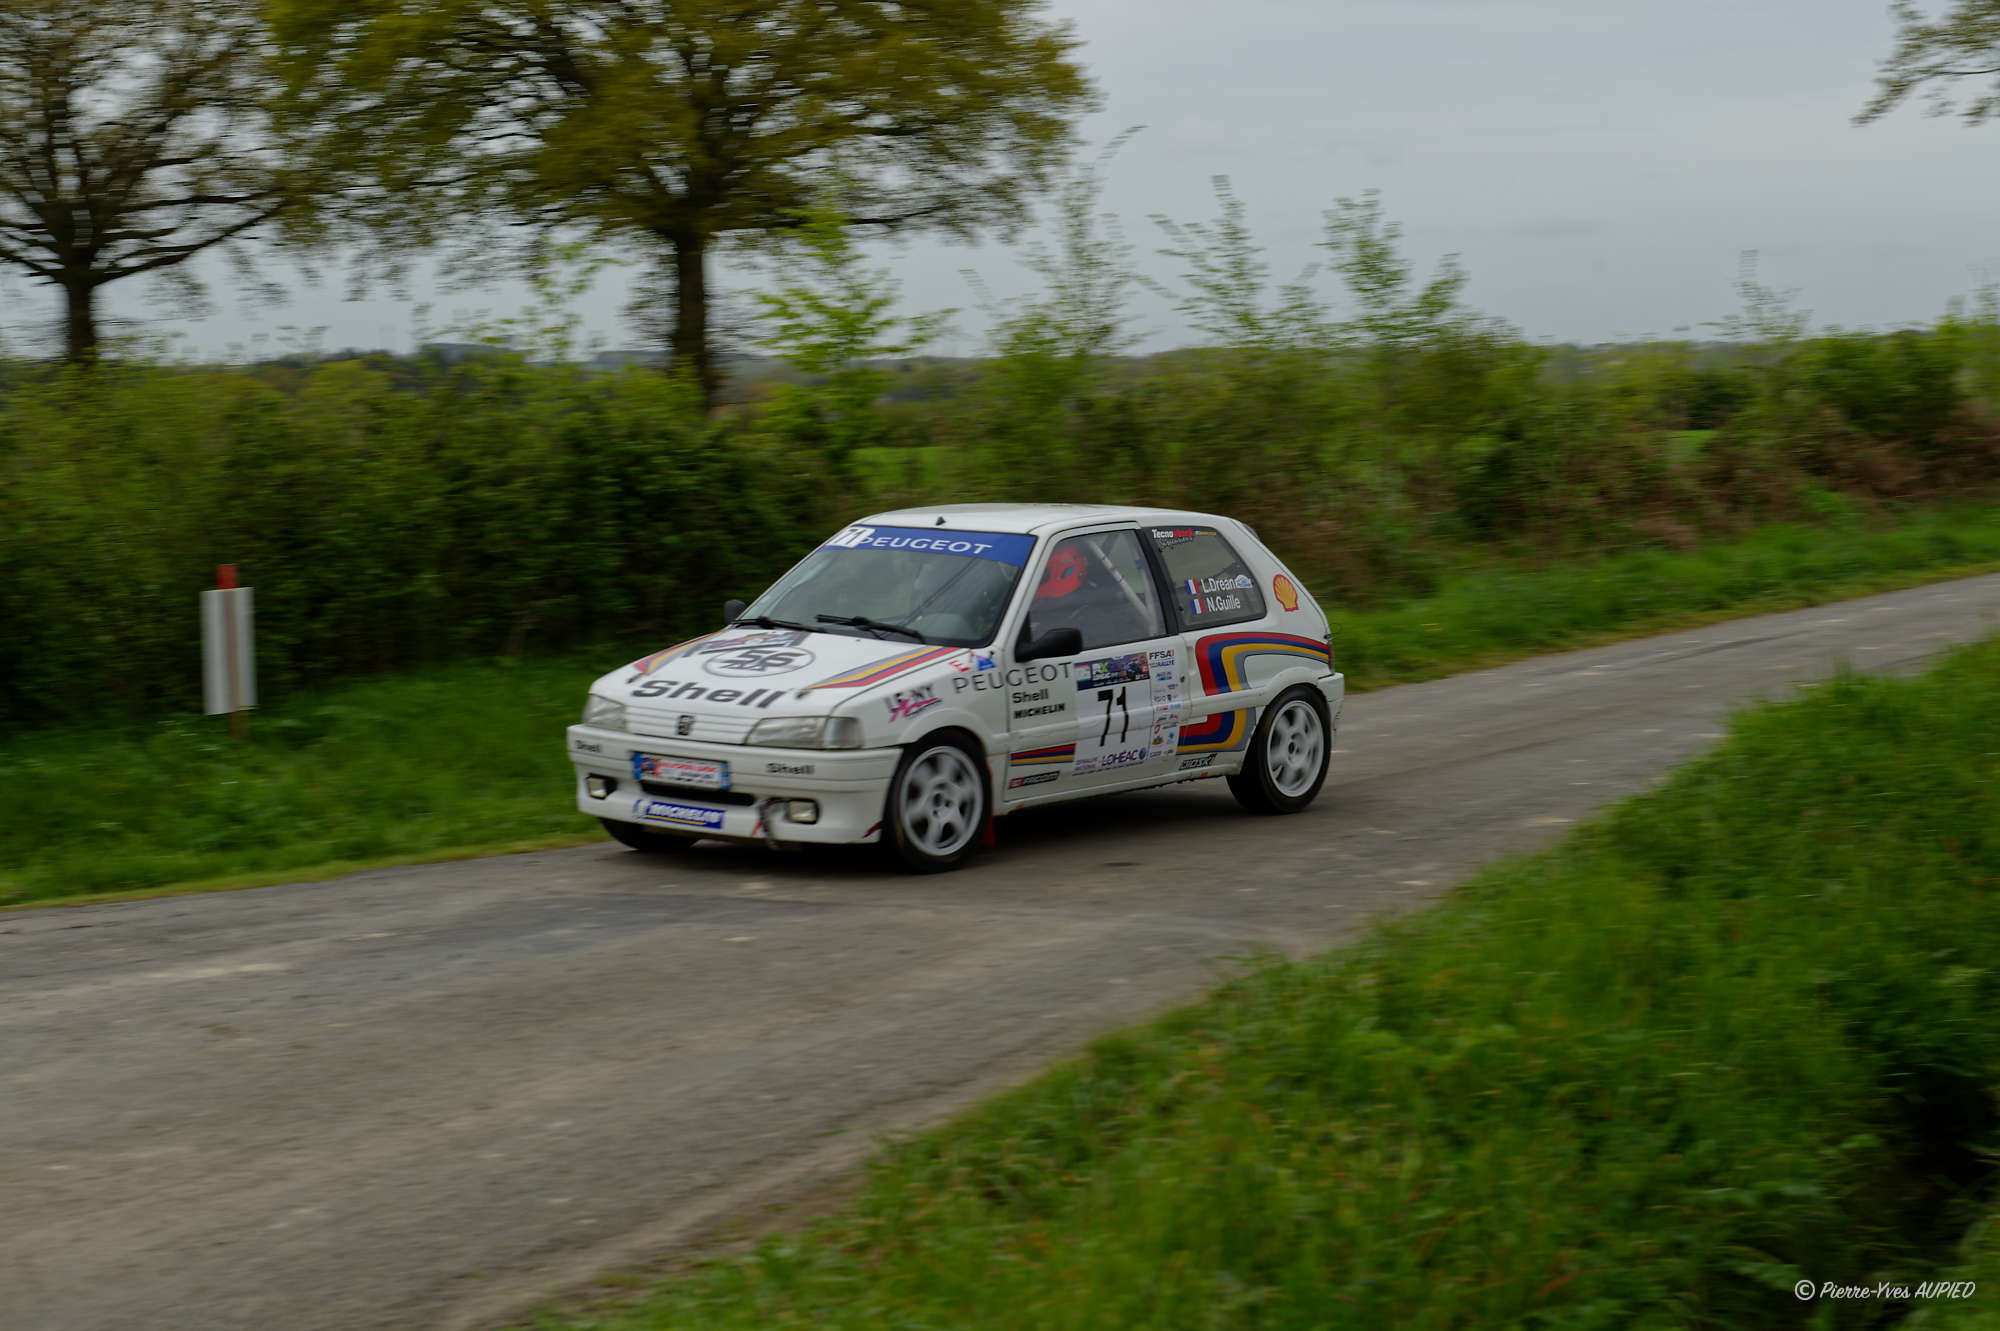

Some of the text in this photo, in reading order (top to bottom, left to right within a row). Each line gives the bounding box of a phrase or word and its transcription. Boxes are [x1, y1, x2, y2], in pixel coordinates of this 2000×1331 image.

[858, 537, 992, 554] PEUGEOT
[1206, 596, 1240, 612] N.Guille
[952, 662, 1072, 693] PEUGEOT
[631, 680, 785, 708] Shell
[1012, 689, 1048, 703] Shell
[1014, 703, 1065, 719] MICHELIN
[1097, 686, 1129, 746] 71
[766, 763, 815, 775] Shell
